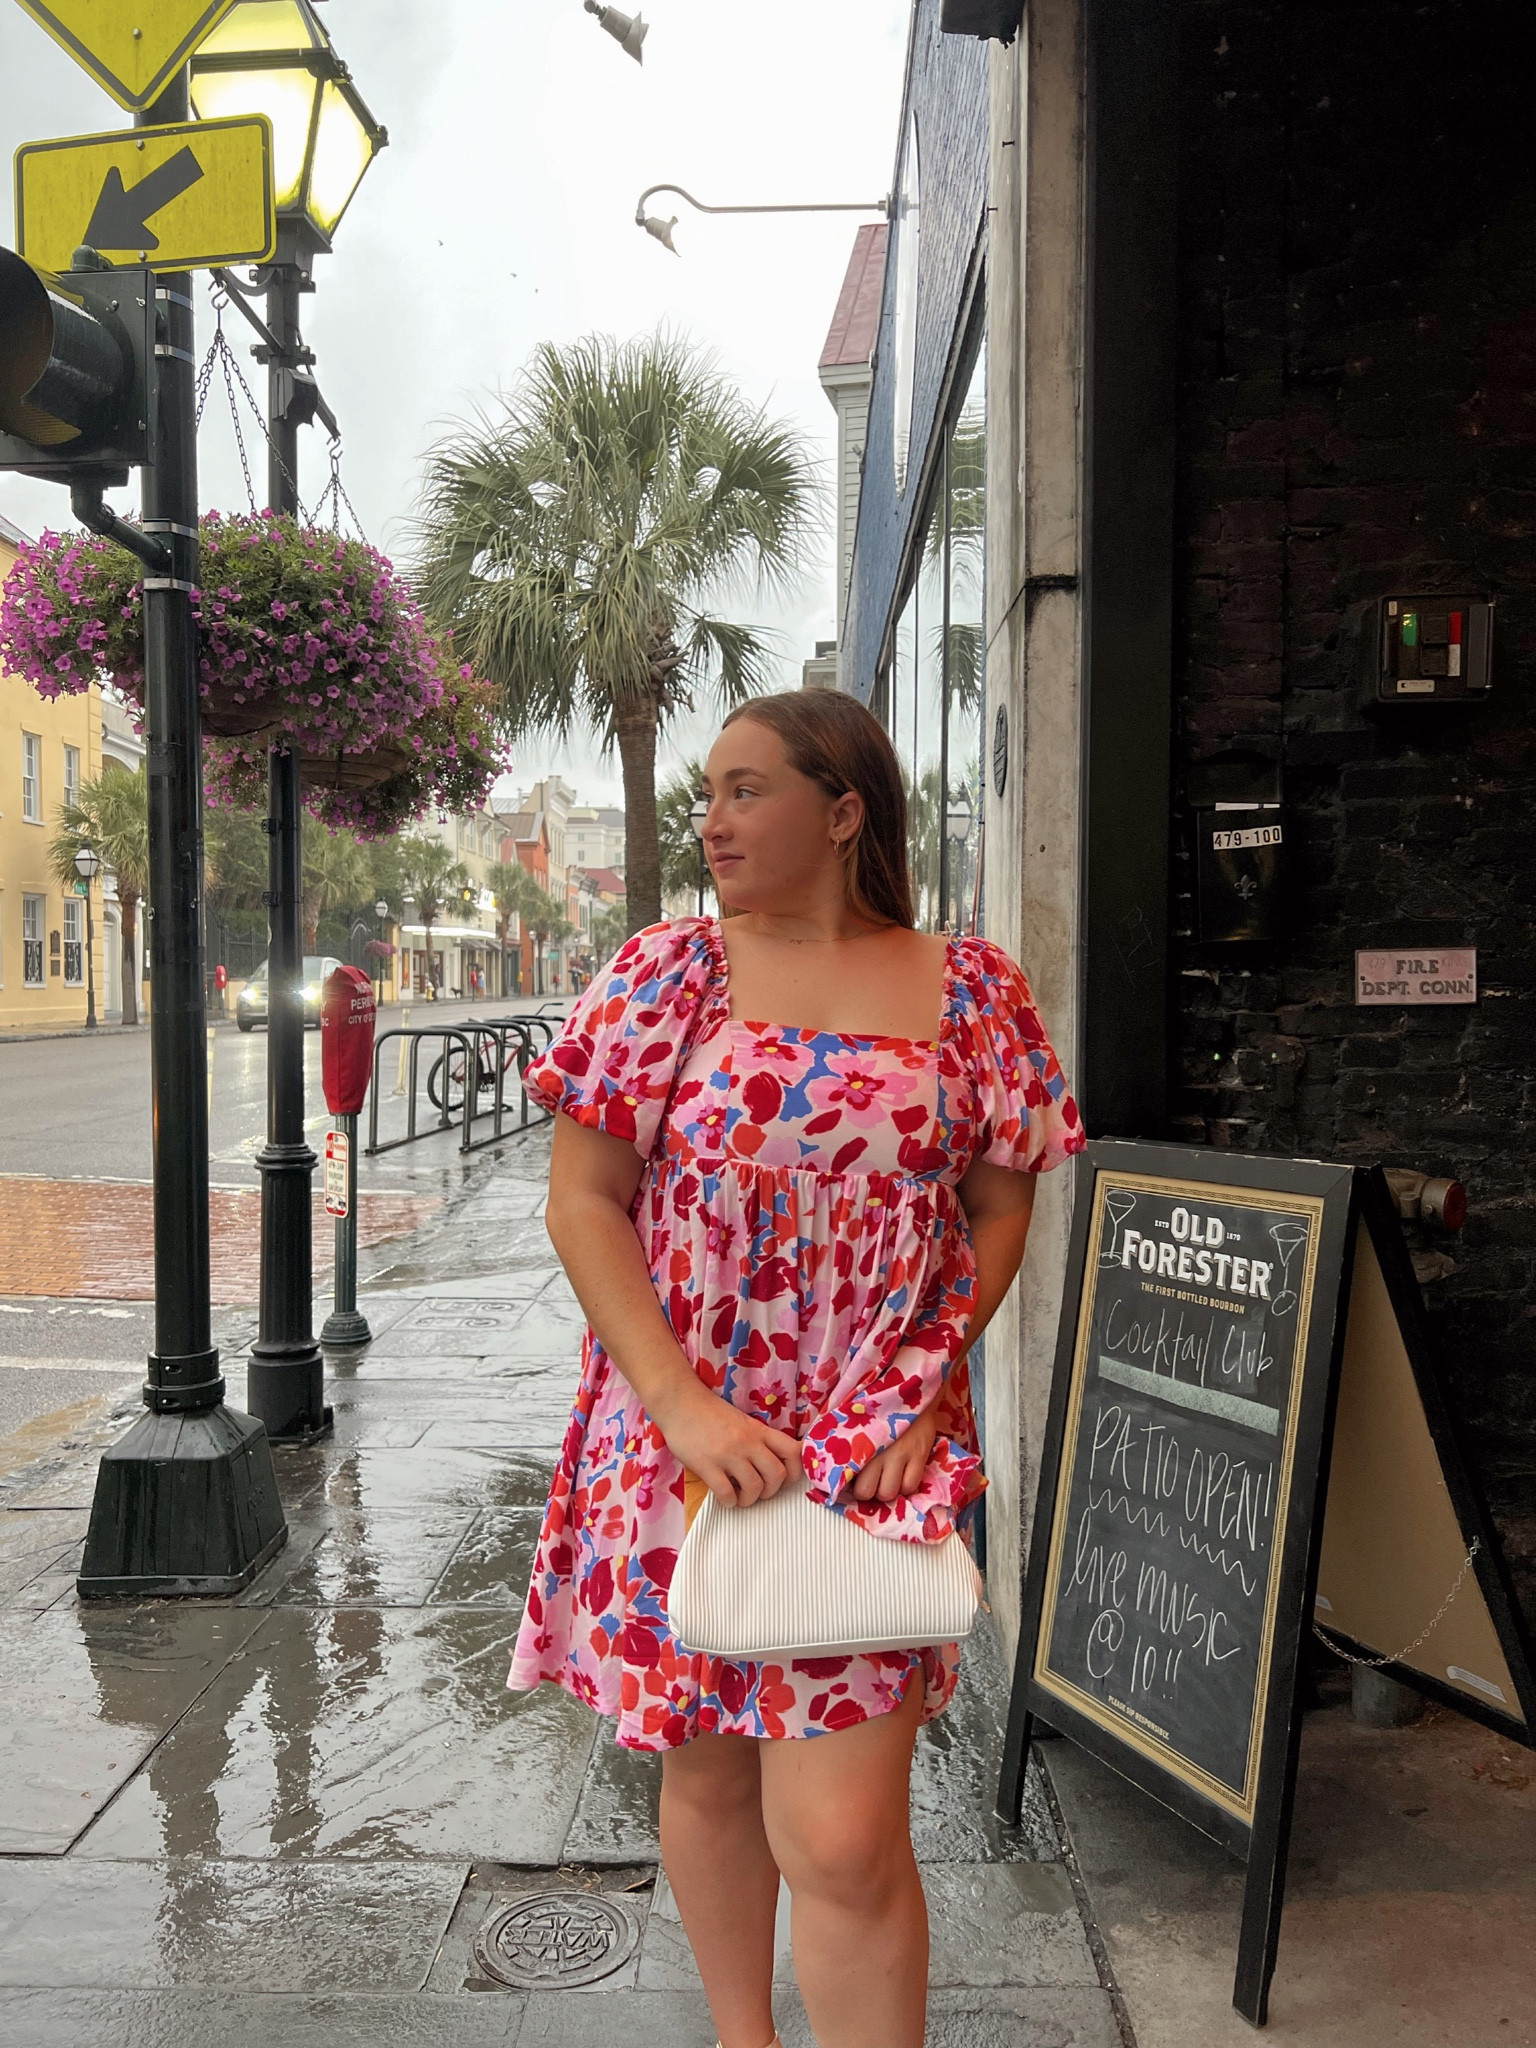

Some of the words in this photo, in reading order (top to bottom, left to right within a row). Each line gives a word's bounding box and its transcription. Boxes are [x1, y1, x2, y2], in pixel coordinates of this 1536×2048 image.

[1214, 827, 1280, 847] 479-100
[1396, 959, 1439, 974] FIRE
[1361, 980, 1411, 996] DEPT.
[1419, 979, 1473, 995] CONN.
[349, 1015, 362, 1024] CITY
[1170, 1206, 1225, 1248] OLD
[1226, 1231, 1241, 1242] 1870
[1121, 1229, 1272, 1300] FORESTER
[1140, 1281, 1154, 1292] THE
[1155, 1284, 1176, 1297] FIRST
[1176, 1289, 1208, 1306] BOTTLED
[1209, 1297, 1245, 1315] BOURBON
[1222, 1324, 1274, 1383] Club
[1086, 1609, 1125, 1679] @
